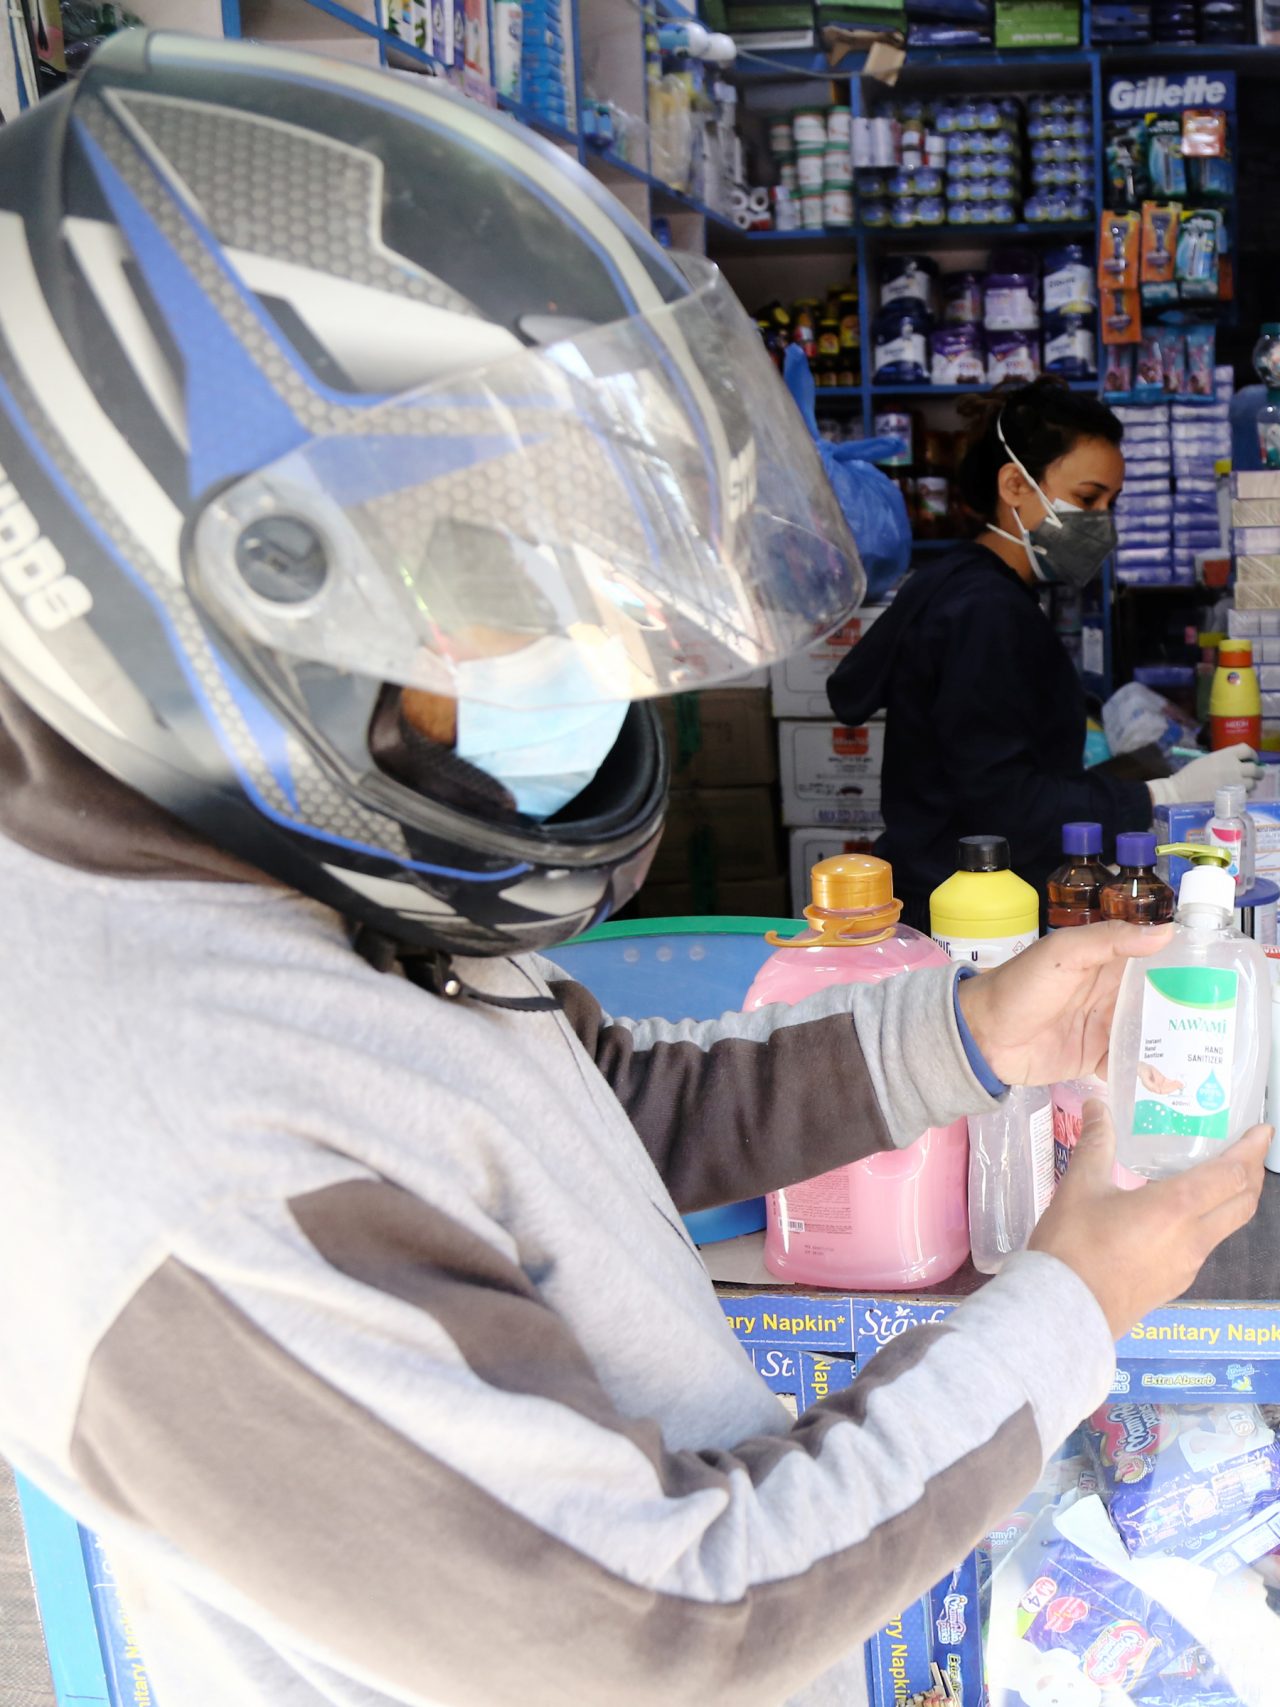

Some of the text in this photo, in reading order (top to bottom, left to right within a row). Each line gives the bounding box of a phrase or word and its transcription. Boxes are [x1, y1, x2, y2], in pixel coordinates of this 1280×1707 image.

[1109, 76, 1227, 111] Gillette
[1204, 1046, 1224, 1055] HAND
[1187, 1054, 1224, 1065] SANITIZER
[1130, 1323, 1220, 1345] Sanitary
[1142, 1374, 1217, 1387] Extra Absorb
